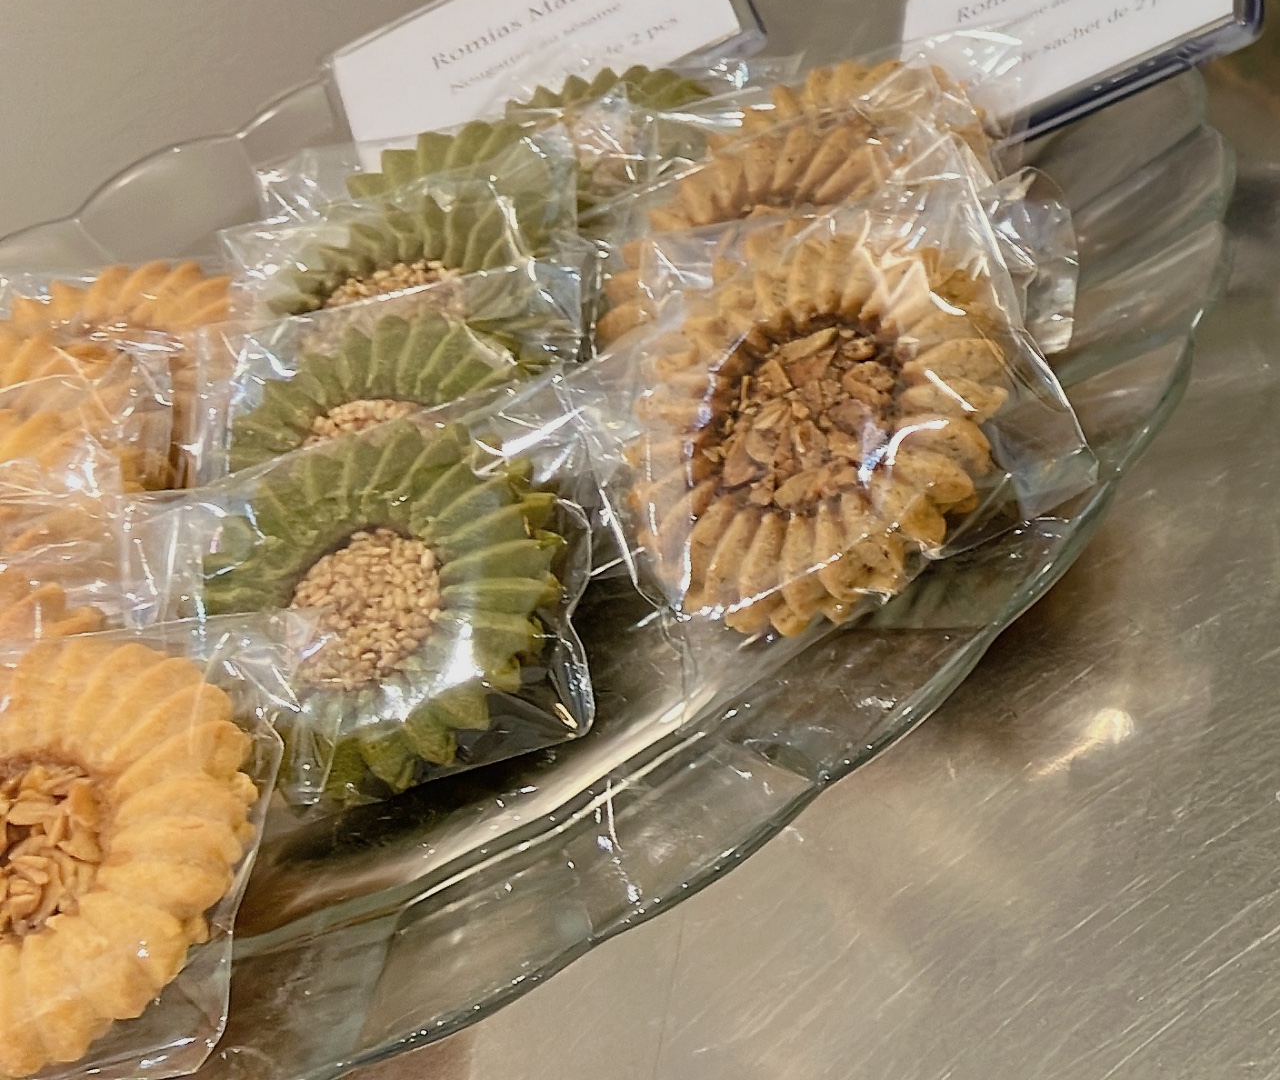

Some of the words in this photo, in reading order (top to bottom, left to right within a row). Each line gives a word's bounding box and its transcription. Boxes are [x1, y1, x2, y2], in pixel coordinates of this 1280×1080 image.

[431, 17, 524, 70] Romias
[627, 32, 643, 47] 2
[1042, 18, 1103, 53] sachet
[1106, 4, 1130, 25] de
